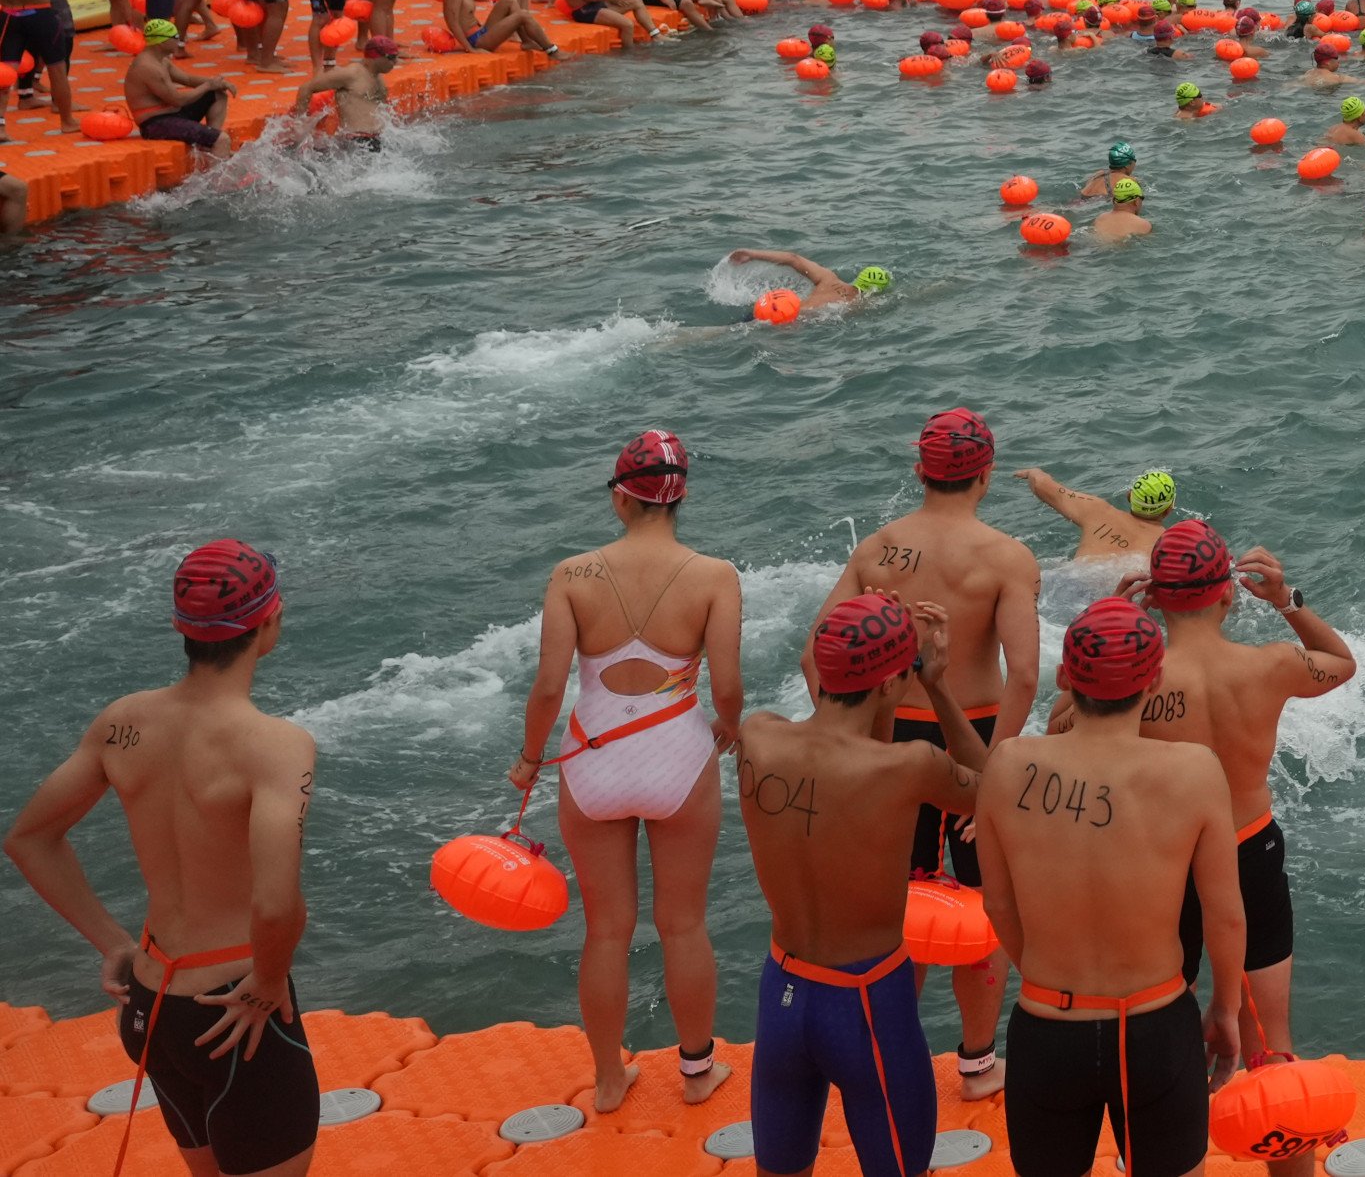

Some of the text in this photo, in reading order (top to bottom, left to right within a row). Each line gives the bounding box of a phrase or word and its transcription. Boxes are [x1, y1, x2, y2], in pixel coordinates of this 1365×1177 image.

[1027, 219, 1055, 232] 1010
[1093, 523, 1129, 549] 1140
[878, 545, 922, 573] 2231
[106, 724, 140, 750] 2130
[1017, 762, 1113, 828] 2043
